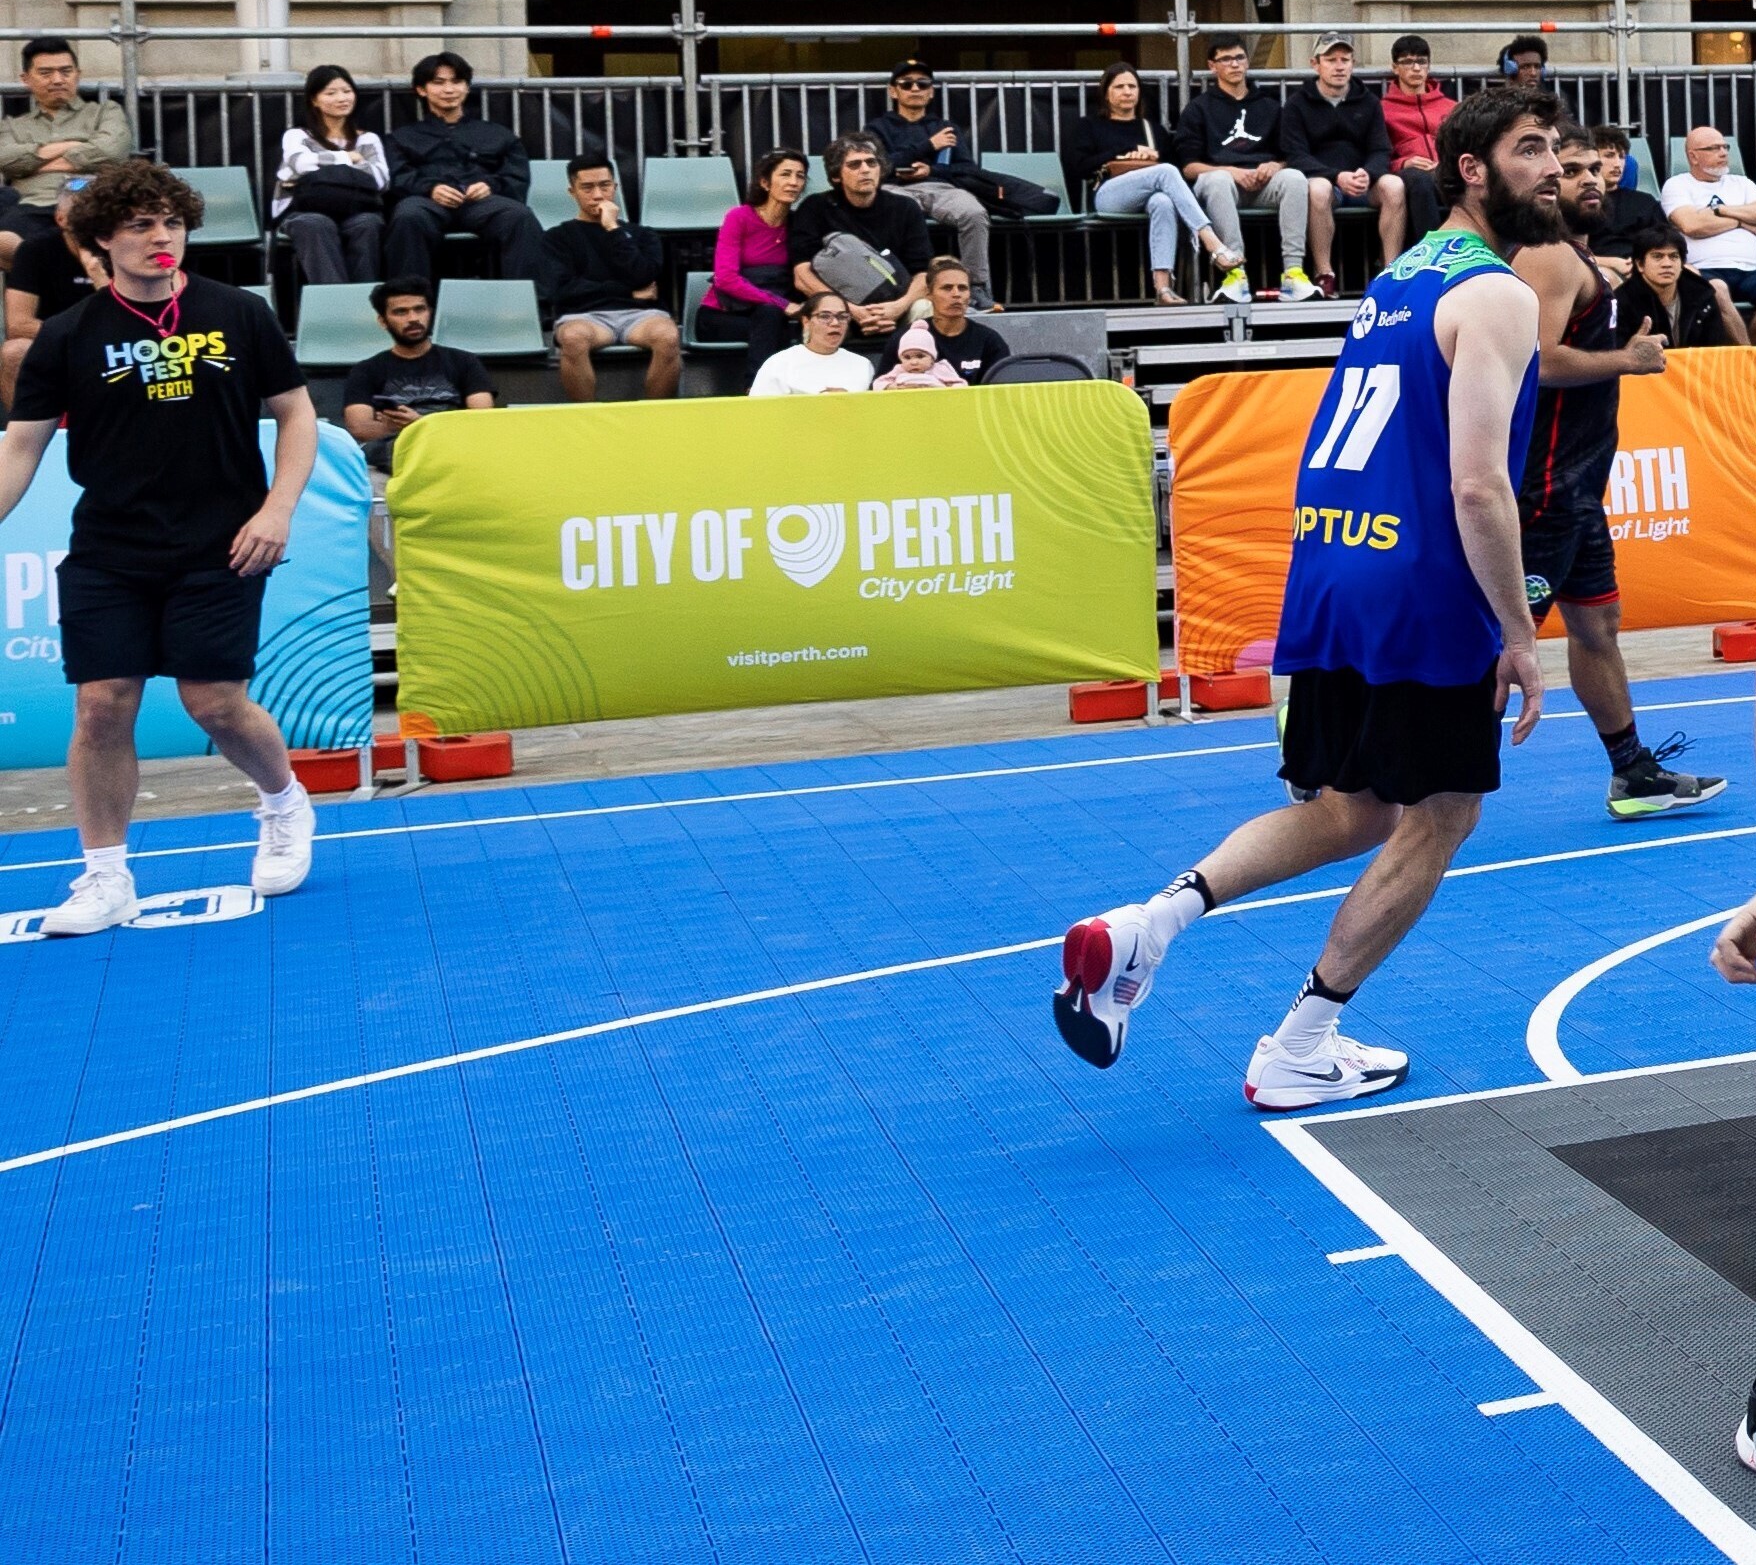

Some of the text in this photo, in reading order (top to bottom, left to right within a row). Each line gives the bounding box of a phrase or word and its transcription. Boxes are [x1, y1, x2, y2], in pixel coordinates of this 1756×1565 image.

[105, 331, 226, 368] HOOPS
[140, 356, 196, 383] FEST
[147, 379, 194, 400] PERTH
[1308, 364, 1400, 471] 17
[1603, 446, 1690, 515] RTH
[560, 493, 1015, 591] CITY OF PERTH
[1609, 516, 1690, 543] of Light
[859, 570, 1015, 602] City of Light
[5, 636, 63, 663] City
[727, 644, 868, 668] visitperth.com
